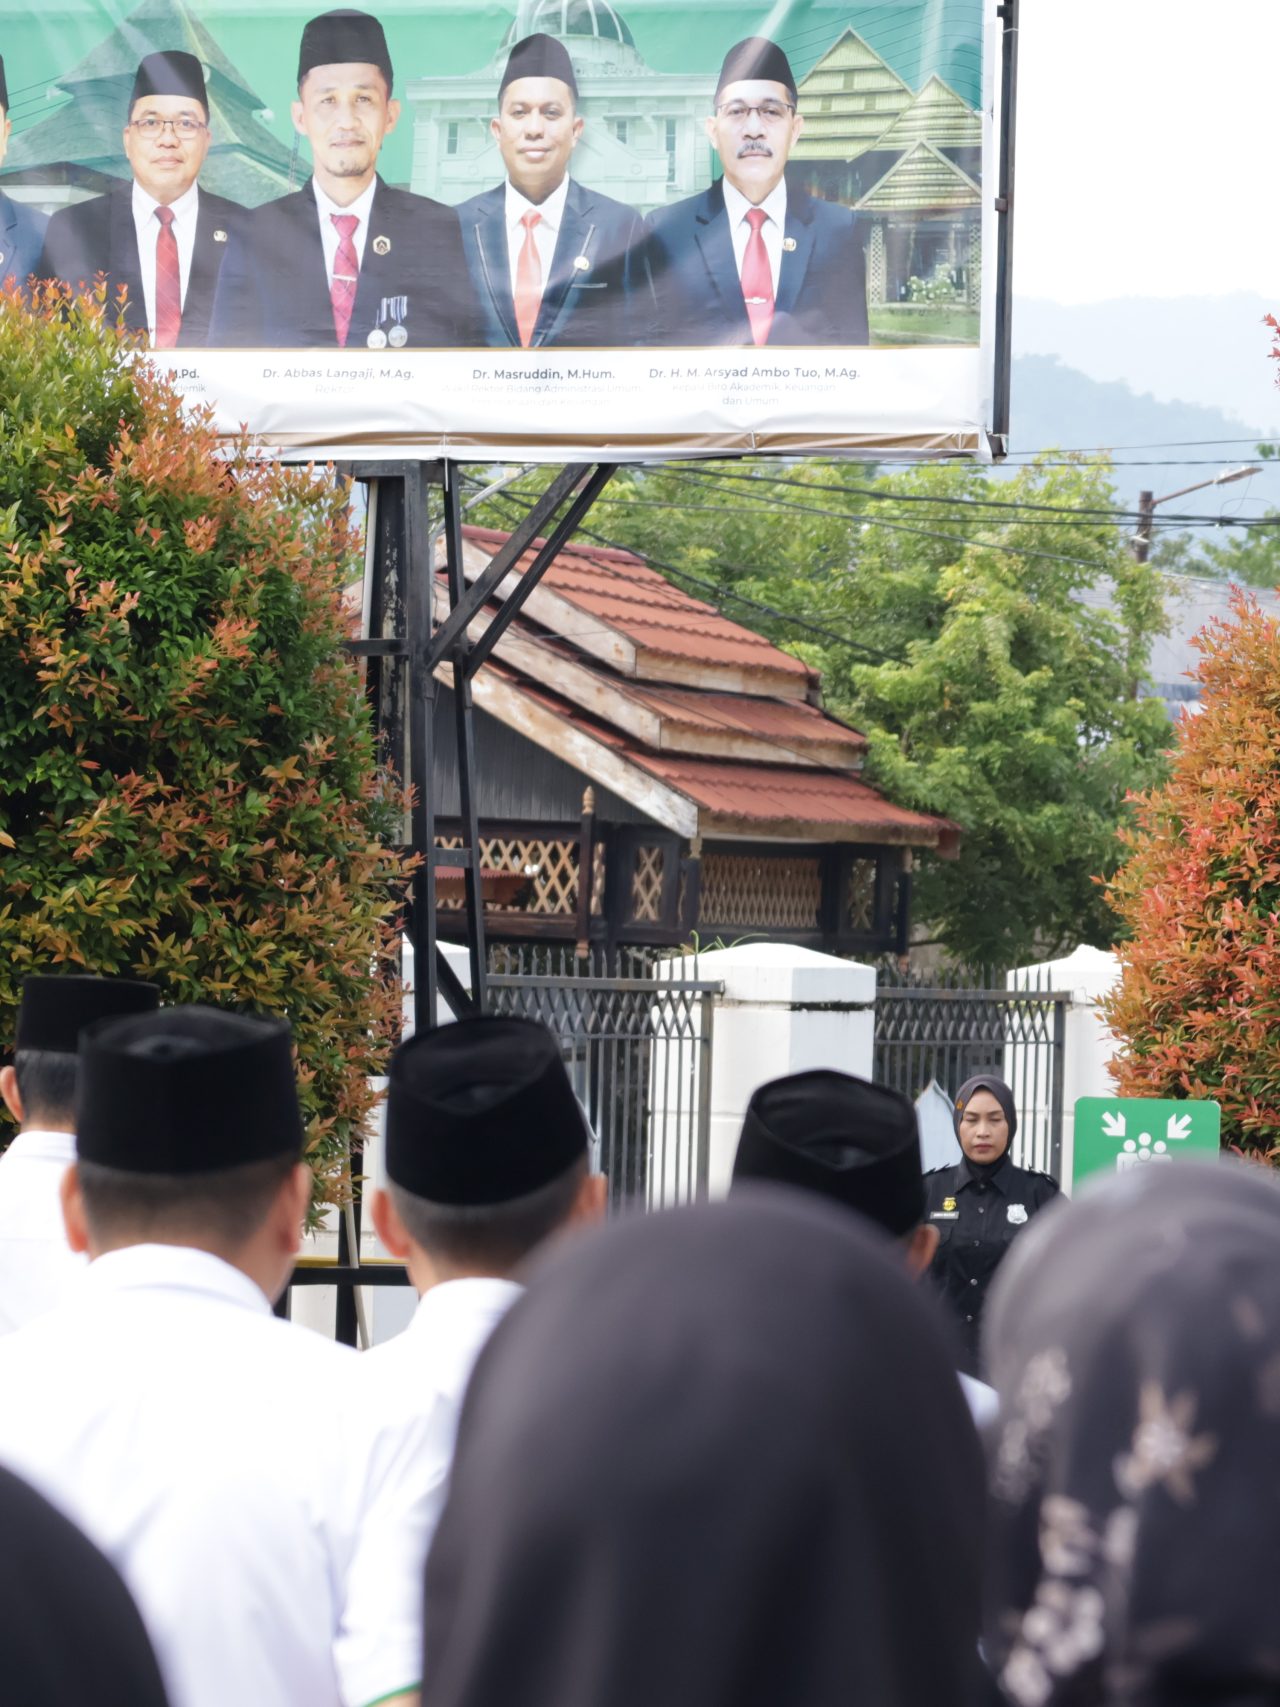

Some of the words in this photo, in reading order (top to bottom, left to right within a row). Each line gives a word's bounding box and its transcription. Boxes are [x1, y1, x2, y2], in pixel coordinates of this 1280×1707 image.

[262, 368, 280, 379] Dr.
[284, 368, 323, 378] Abbas
[325, 368, 375, 381] Langaji,
[379, 369, 416, 381] M.Ag.
[472, 369, 490, 379] Dr.
[494, 367, 564, 381] Masruddin,
[567, 368, 616, 380] M.Hum.
[648, 368, 667, 379] Dr.
[671, 369, 683, 378] H.
[687, 369, 702, 378] M.
[705, 367, 749, 380] Arsyad
[751, 367, 791, 379] Ambo
[793, 367, 822, 379] Tuo,
[825, 367, 861, 381] M.Ag.
[722, 395, 743, 406] dan
